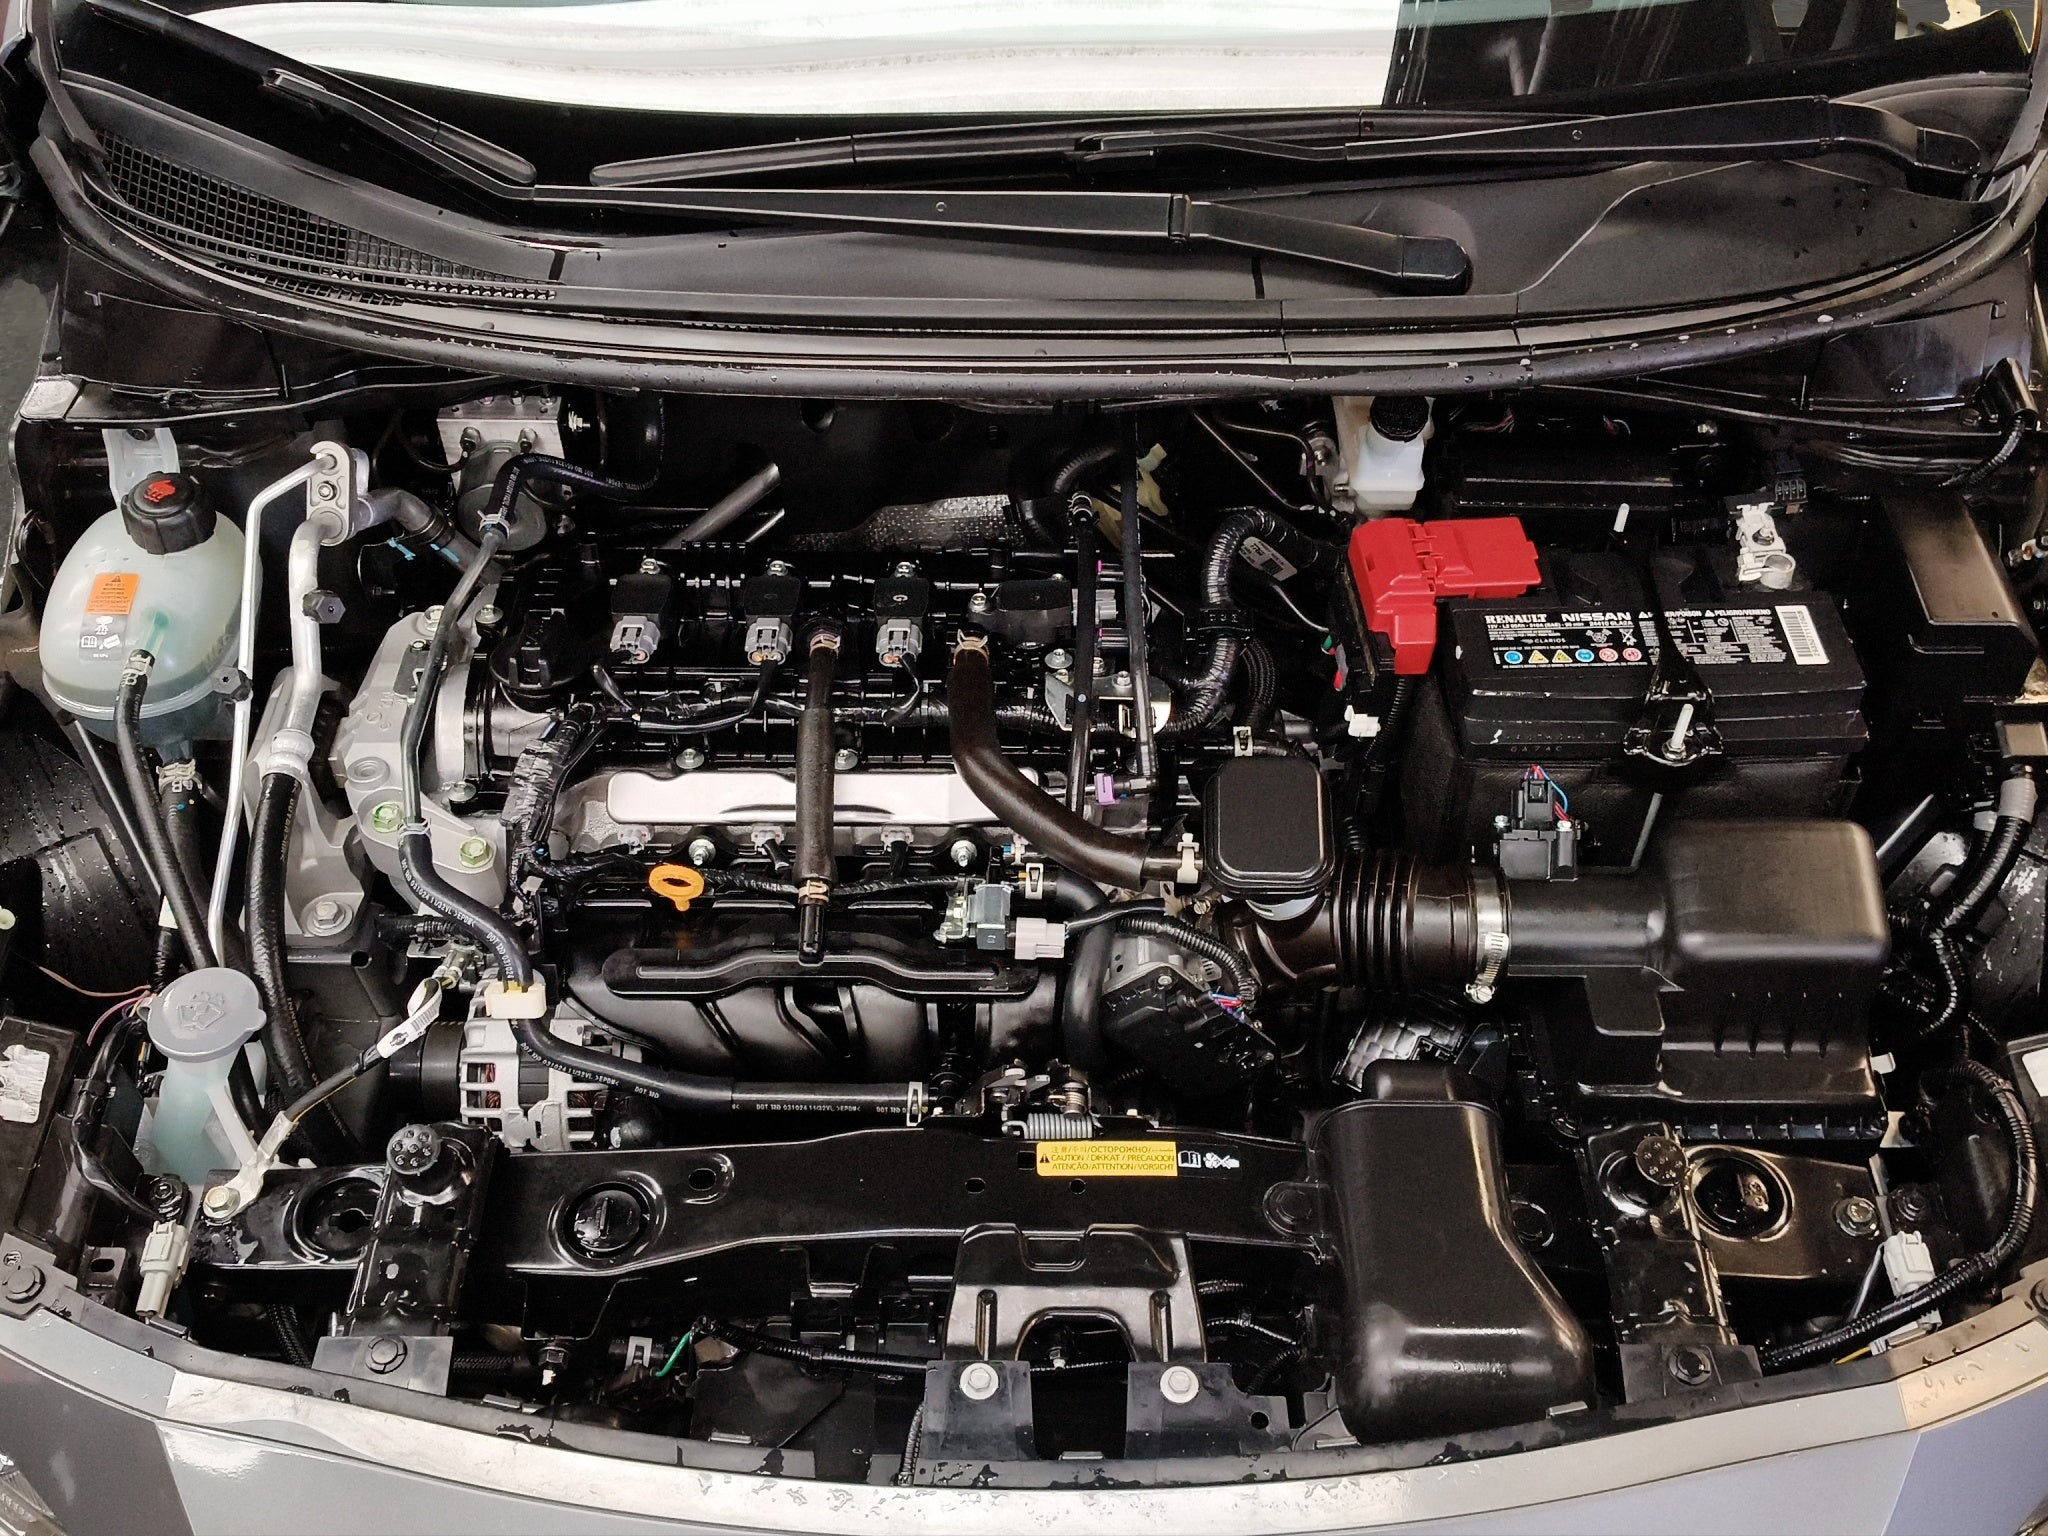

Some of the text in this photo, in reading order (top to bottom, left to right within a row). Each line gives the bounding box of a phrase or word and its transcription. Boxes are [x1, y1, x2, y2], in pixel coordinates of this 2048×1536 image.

[1484, 612, 1632, 624] RENAULT NISSAN
[486, 931, 500, 945] DOT
[756, 1103, 769, 1111] DOT
[876, 1106, 889, 1114] DOT
[1051, 1154, 1084, 1162] CAUTION
[1091, 1154, 1120, 1162] DIKKAT
